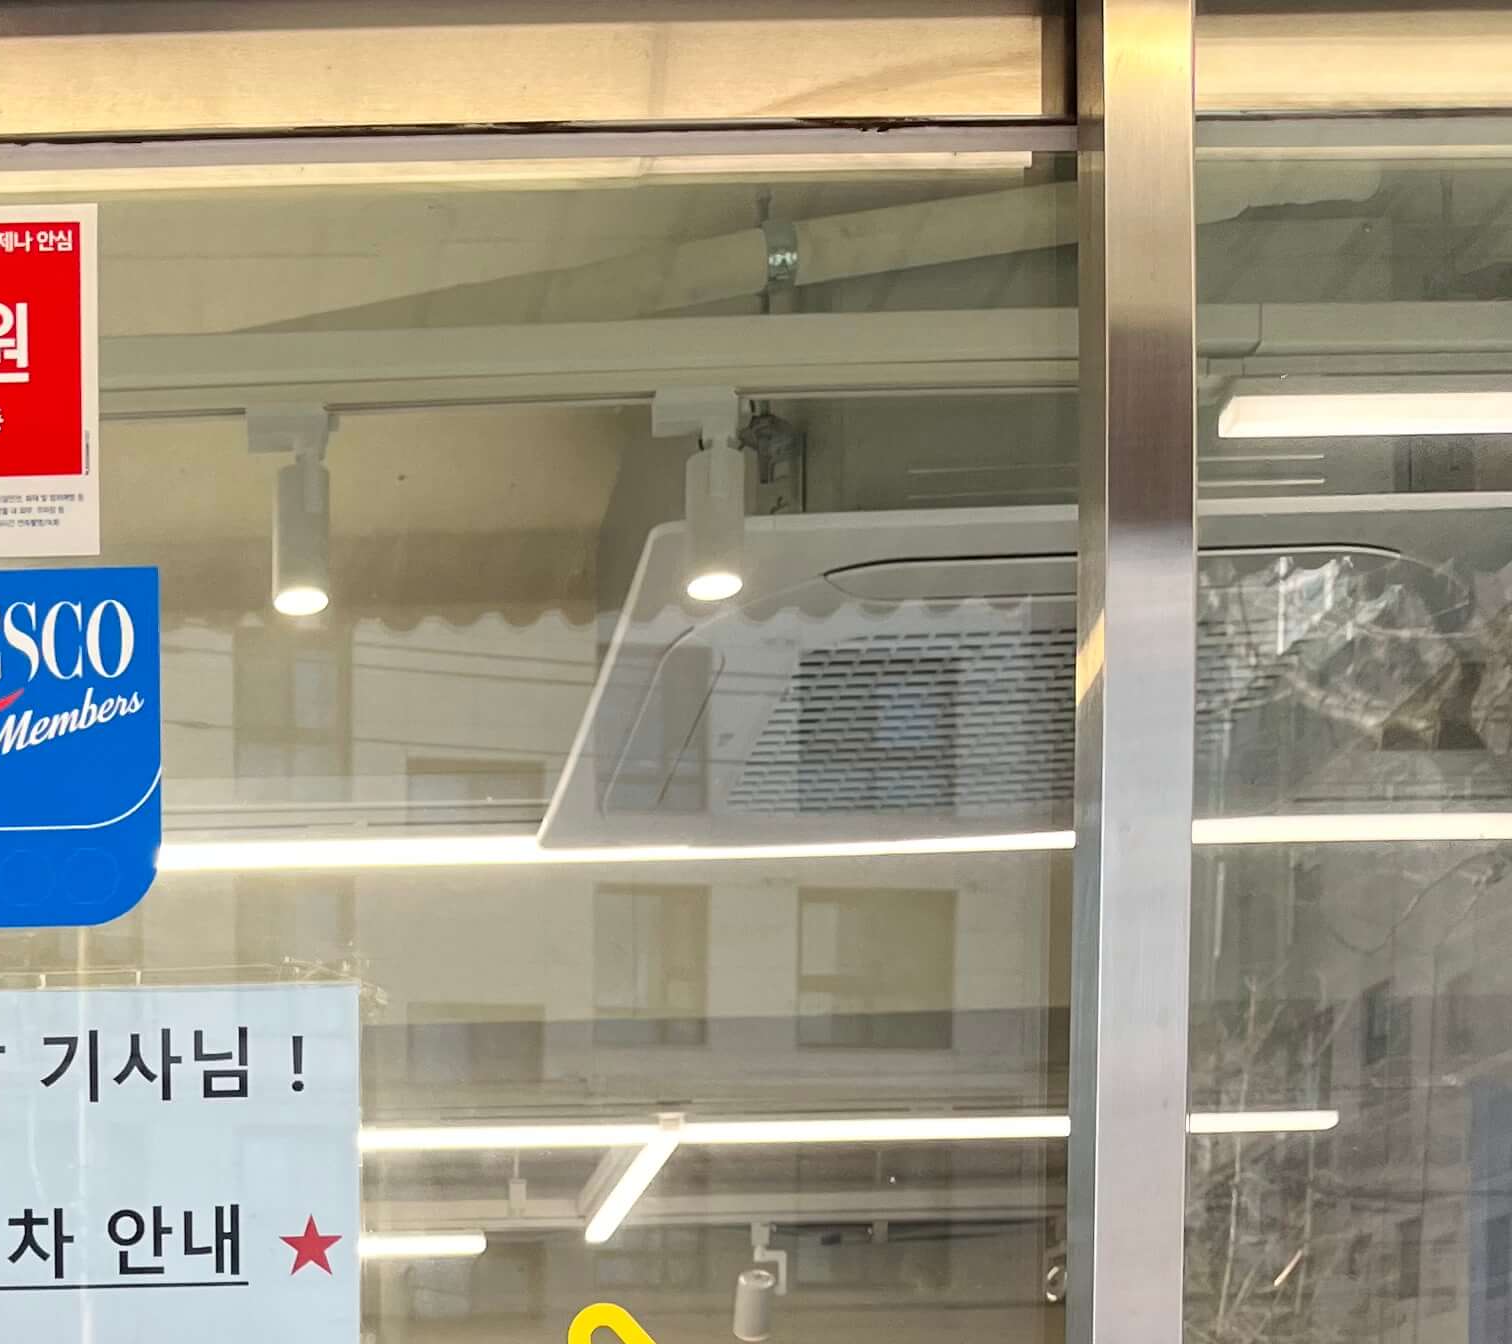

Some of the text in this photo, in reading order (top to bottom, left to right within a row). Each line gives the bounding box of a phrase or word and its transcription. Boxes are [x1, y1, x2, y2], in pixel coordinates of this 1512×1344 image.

[36, 230, 73, 253] 안심
[40, 1026, 249, 1103] 기사님
[107, 1203, 241, 1276] 안내
